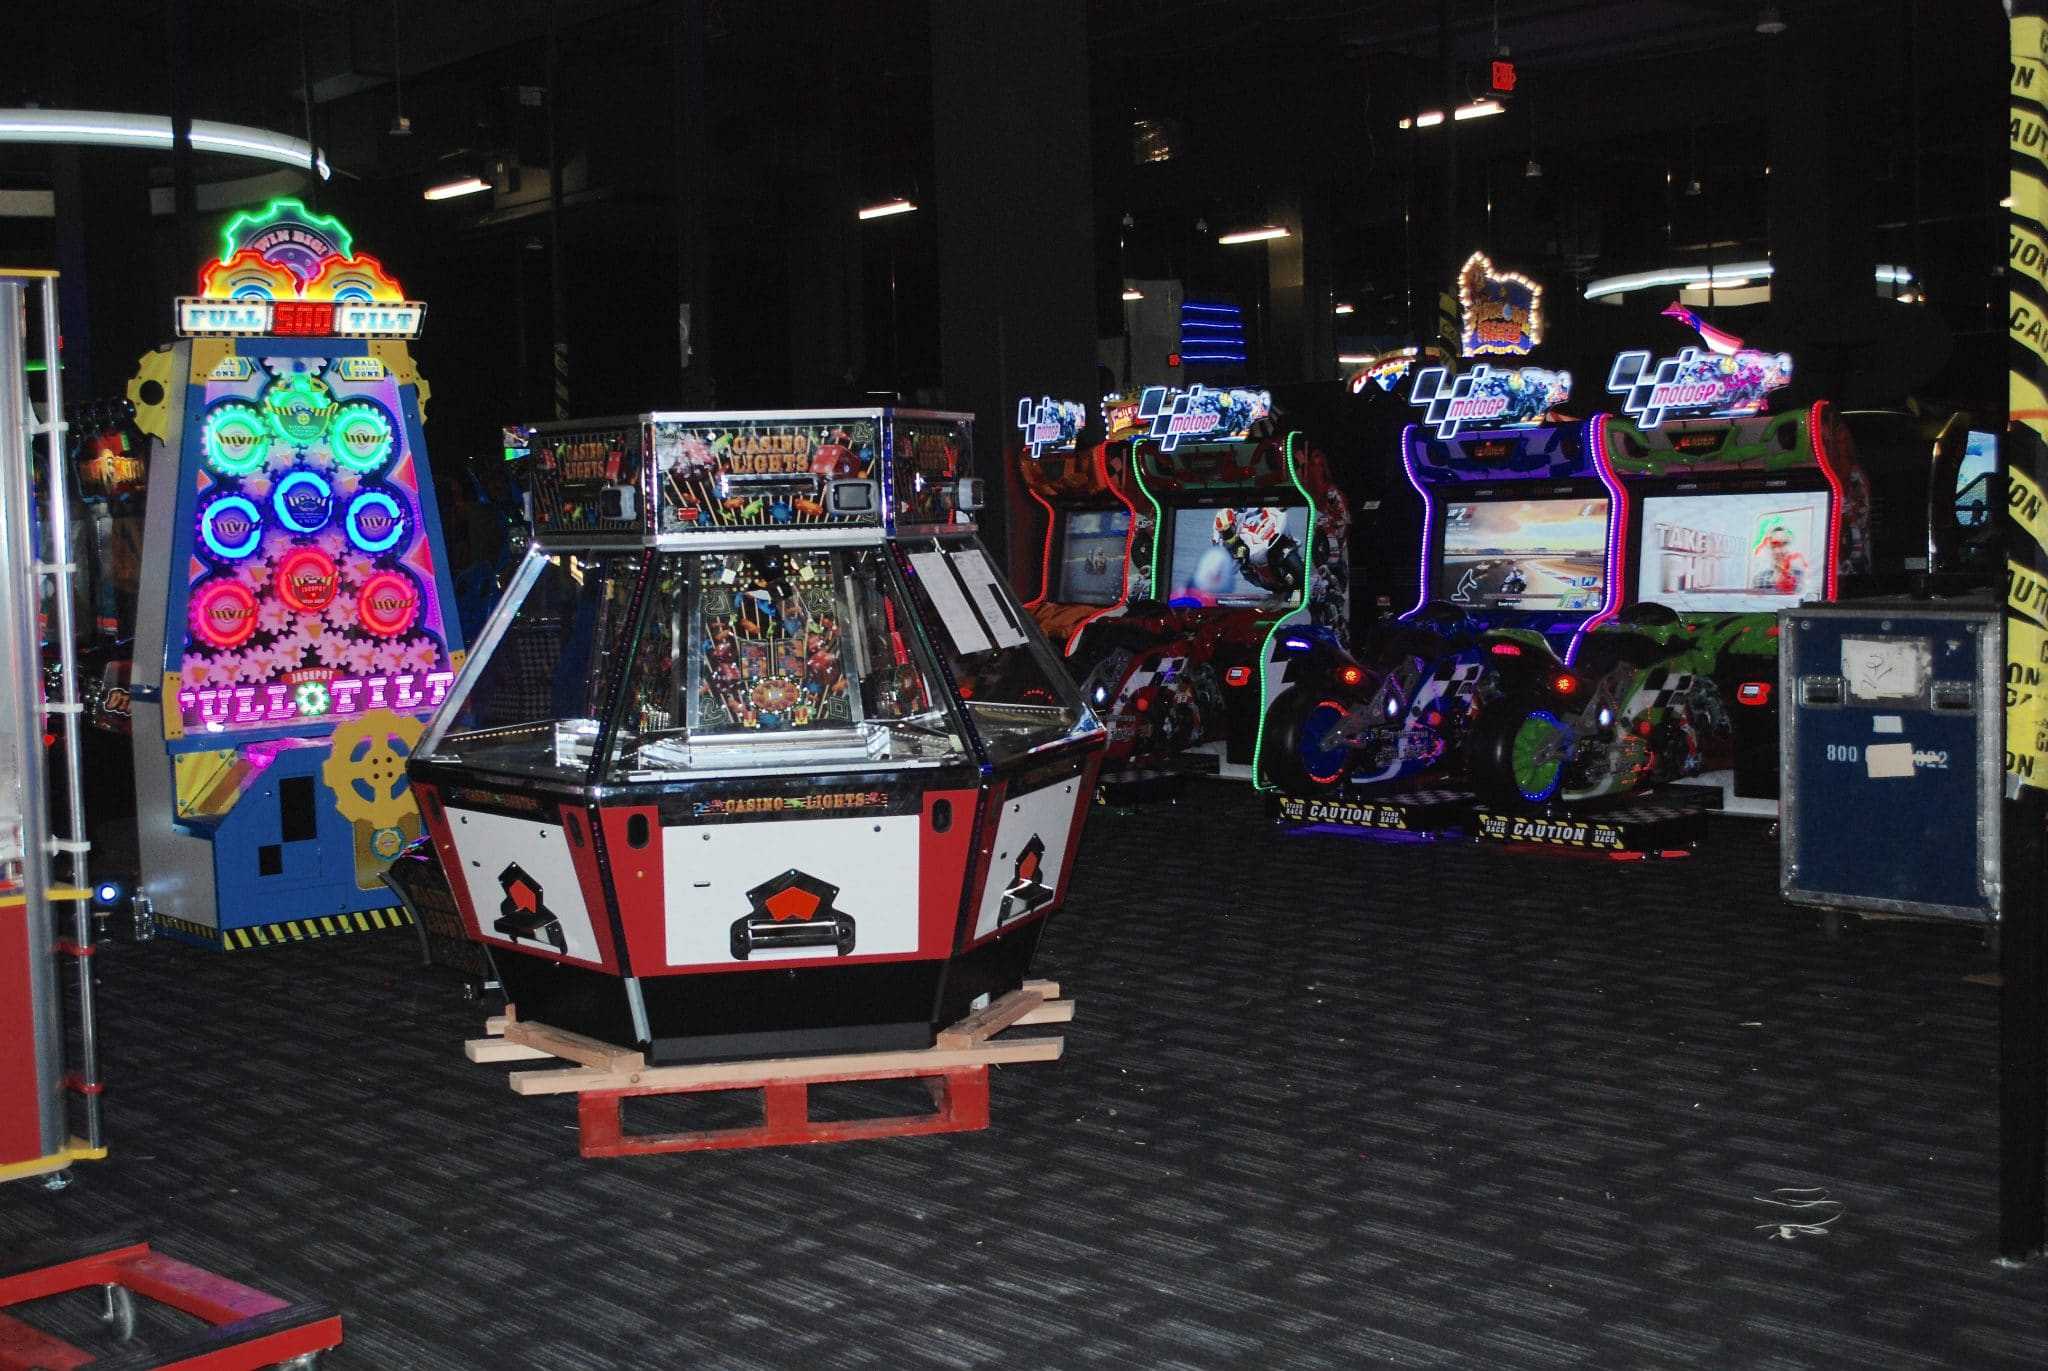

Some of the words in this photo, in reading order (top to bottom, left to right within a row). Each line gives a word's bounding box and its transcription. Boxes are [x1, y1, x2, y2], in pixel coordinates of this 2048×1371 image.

[189, 309, 261, 328] FULL
[350, 312, 412, 330] TILT
[732, 435, 809, 454] CASINO
[732, 454, 809, 473] LIGHTS
[290, 670, 333, 683] JACKPOT
[331, 672, 454, 713] TILT
[1826, 744, 1857, 762] 800
[726, 797, 784, 813] CASINO
[806, 792, 865, 809] LIGHTS
[1310, 805, 1372, 821] CAUTION
[1514, 823, 1585, 841] CAUTION
